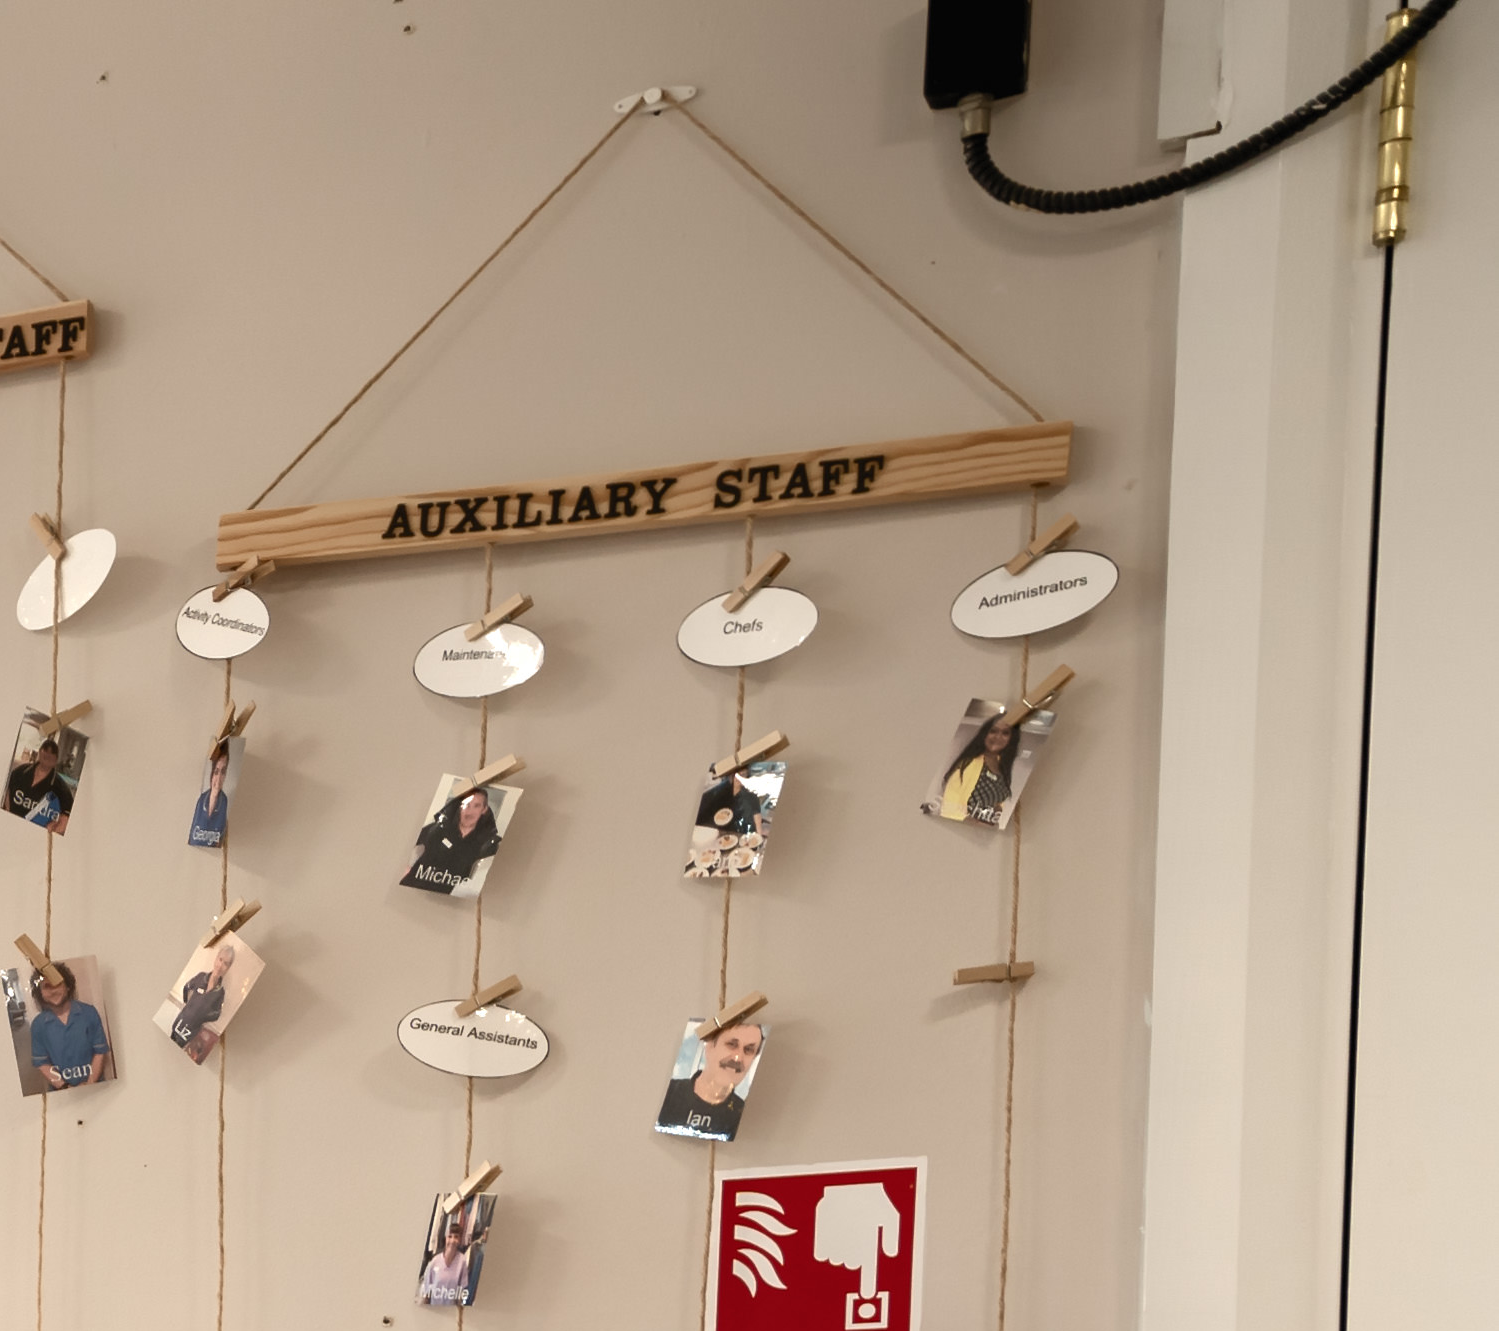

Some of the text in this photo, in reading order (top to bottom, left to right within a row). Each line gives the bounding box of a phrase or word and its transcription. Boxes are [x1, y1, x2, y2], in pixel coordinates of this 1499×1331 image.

[382, 455, 885, 538] AUXILIARY STAFF
[978, 576, 1088, 610] Administrators
[182, 607, 265, 636] Activity Coordinators
[723, 618, 764, 635] Chefs
[12, 788, 61, 822] Sandra
[192, 825, 221, 844] Georgia
[173, 1019, 192, 1041] Liz
[410, 1017, 538, 1049] General Assistants
[48, 1062, 93, 1083] Sean
[686, 1110, 711, 1127] Ian
[420, 1284, 470, 1301] Michelle
